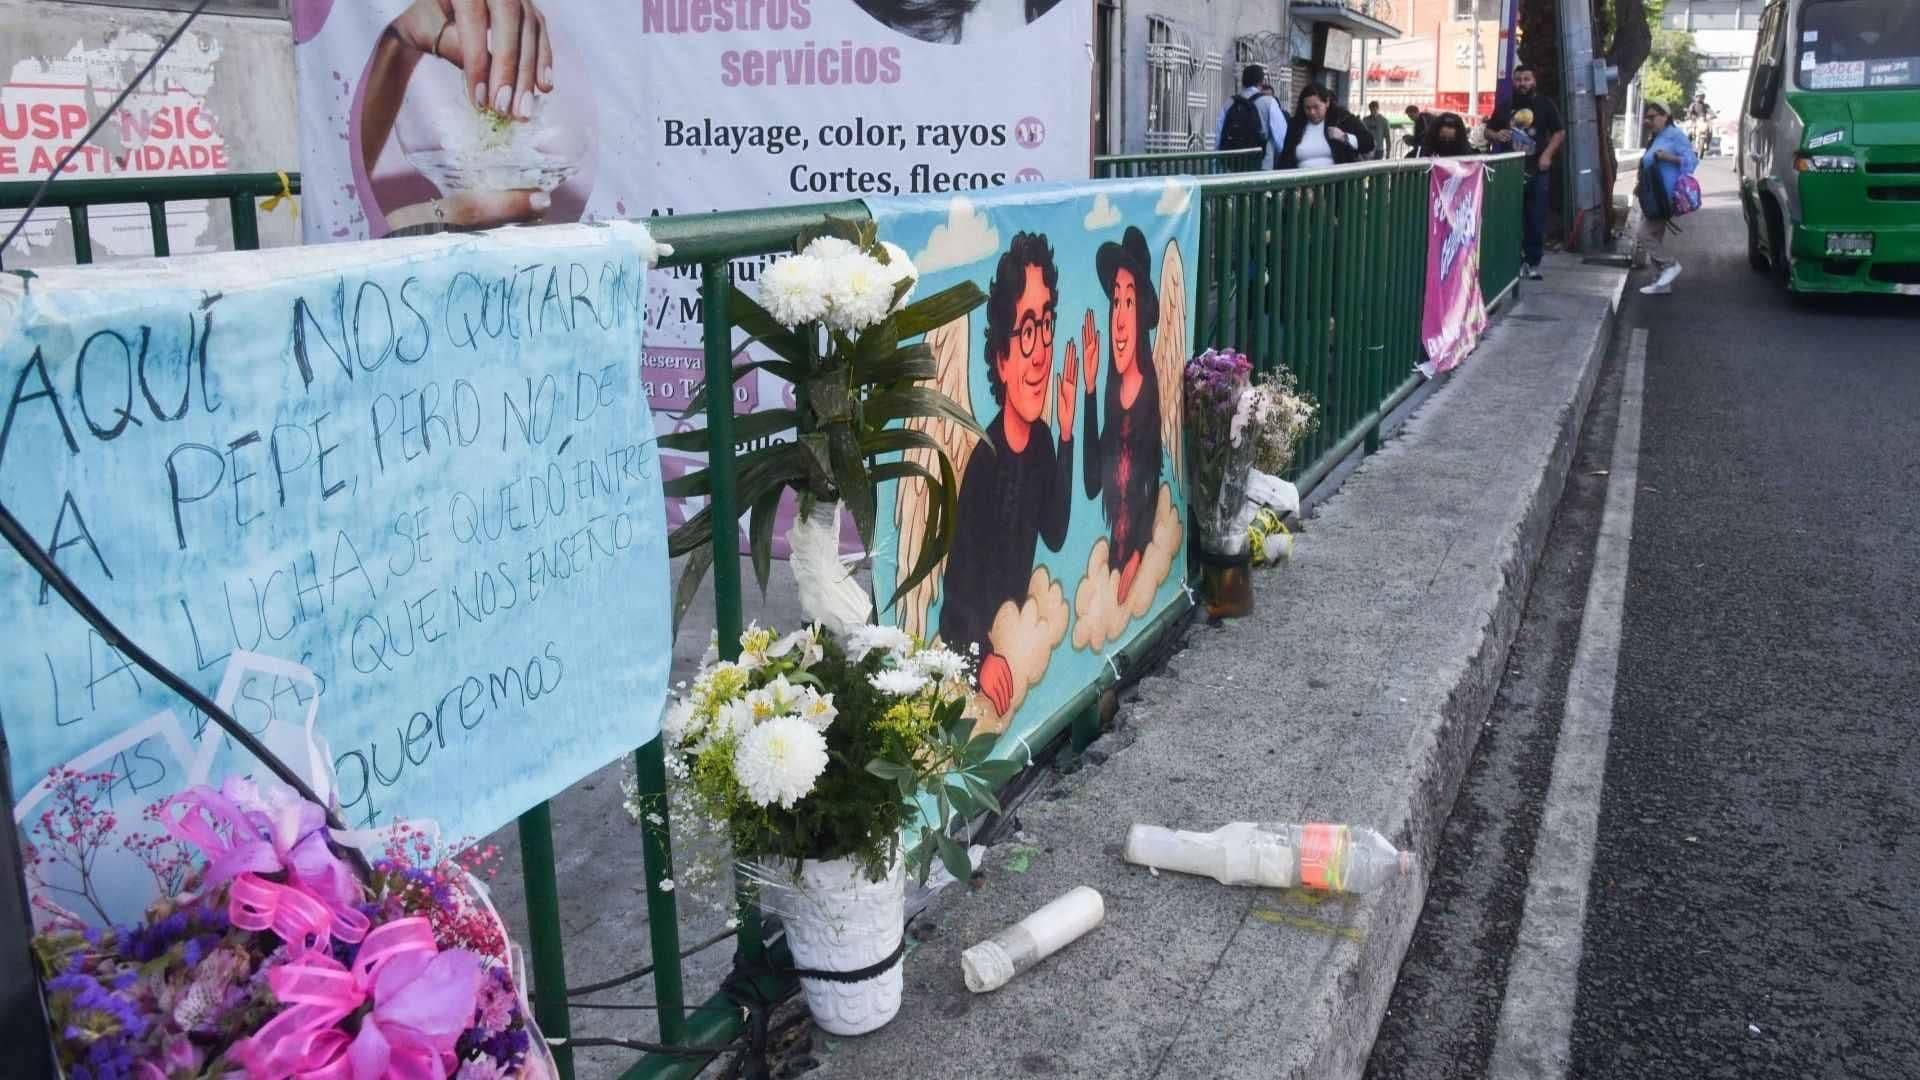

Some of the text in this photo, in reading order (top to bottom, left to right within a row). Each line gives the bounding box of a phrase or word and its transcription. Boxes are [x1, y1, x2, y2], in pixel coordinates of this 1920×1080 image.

[641, 0, 812, 34] Nuestros
[720, 40, 901, 87] servicios
[664, 117, 1006, 154] Balayage, color, rayos
[789, 163, 1006, 196] Cortes, flecos
[0, 257, 642, 467] AQUÍ NOS QUITARON
[39, 489, 114, 606] A
[164, 411, 358, 550] PEPE,
[371, 378, 481, 474] PERO
[574, 363, 617, 422] DE
[45, 628, 142, 727] LA
[388, 506, 433, 577] SE
[574, 438, 658, 500] ENTRE
[351, 588, 448, 674] QUE
[452, 561, 517, 629] NOS
[335, 640, 564, 829] queremos
